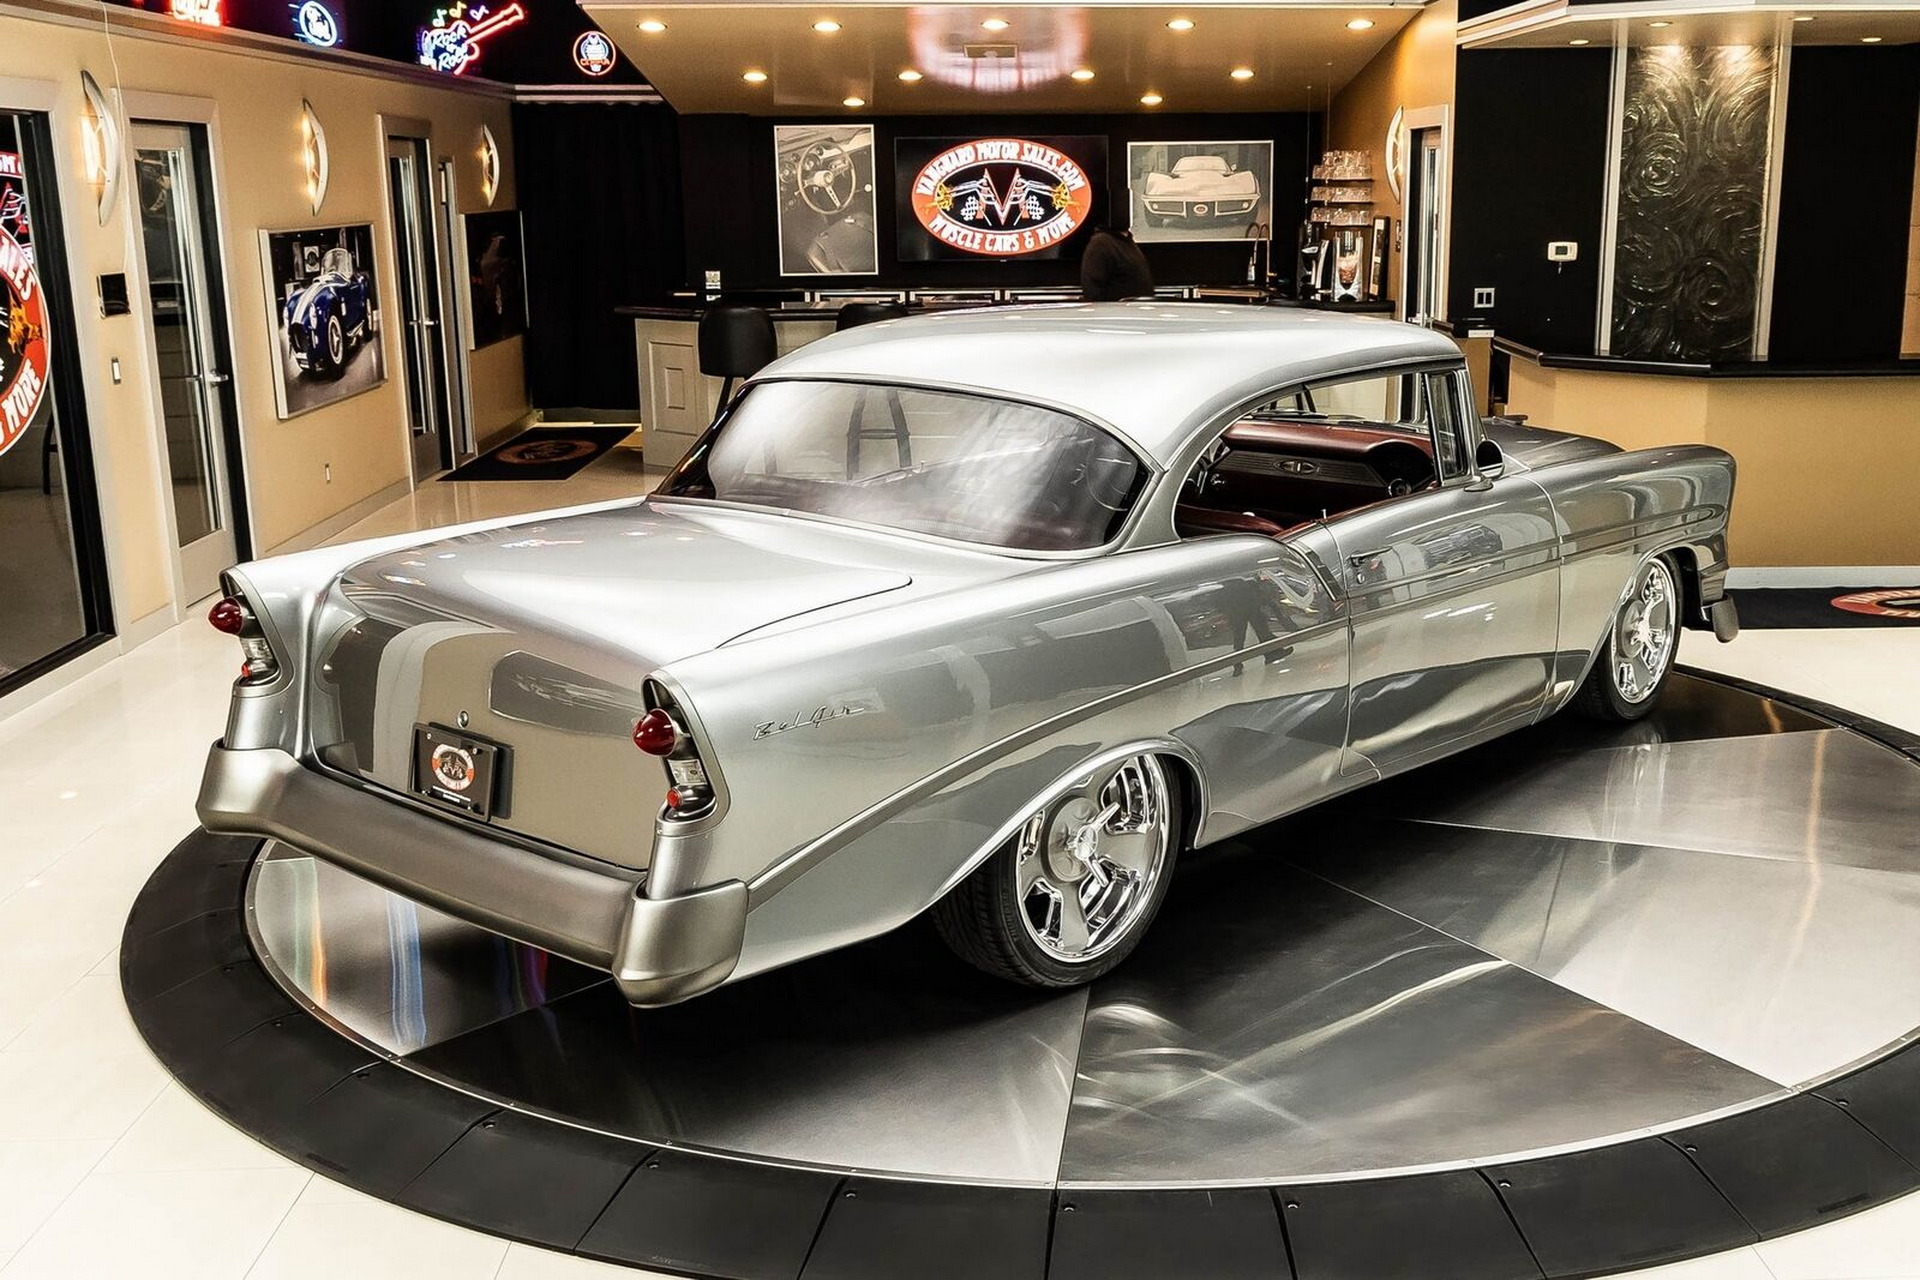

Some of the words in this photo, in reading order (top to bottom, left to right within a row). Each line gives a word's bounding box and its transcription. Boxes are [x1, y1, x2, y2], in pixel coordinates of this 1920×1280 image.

[916, 146, 975, 195] VANGUARD
[976, 141, 1019, 161] MOTOR
[929, 213, 984, 249] MUSCLE
[984, 234, 1019, 251] CARS
[1025, 231, 1034, 248] &
[1036, 212, 1075, 245] MORE
[1, 358, 41, 434] MORE
[752, 710, 802, 740] Bel
[809, 705, 865, 728] Air
